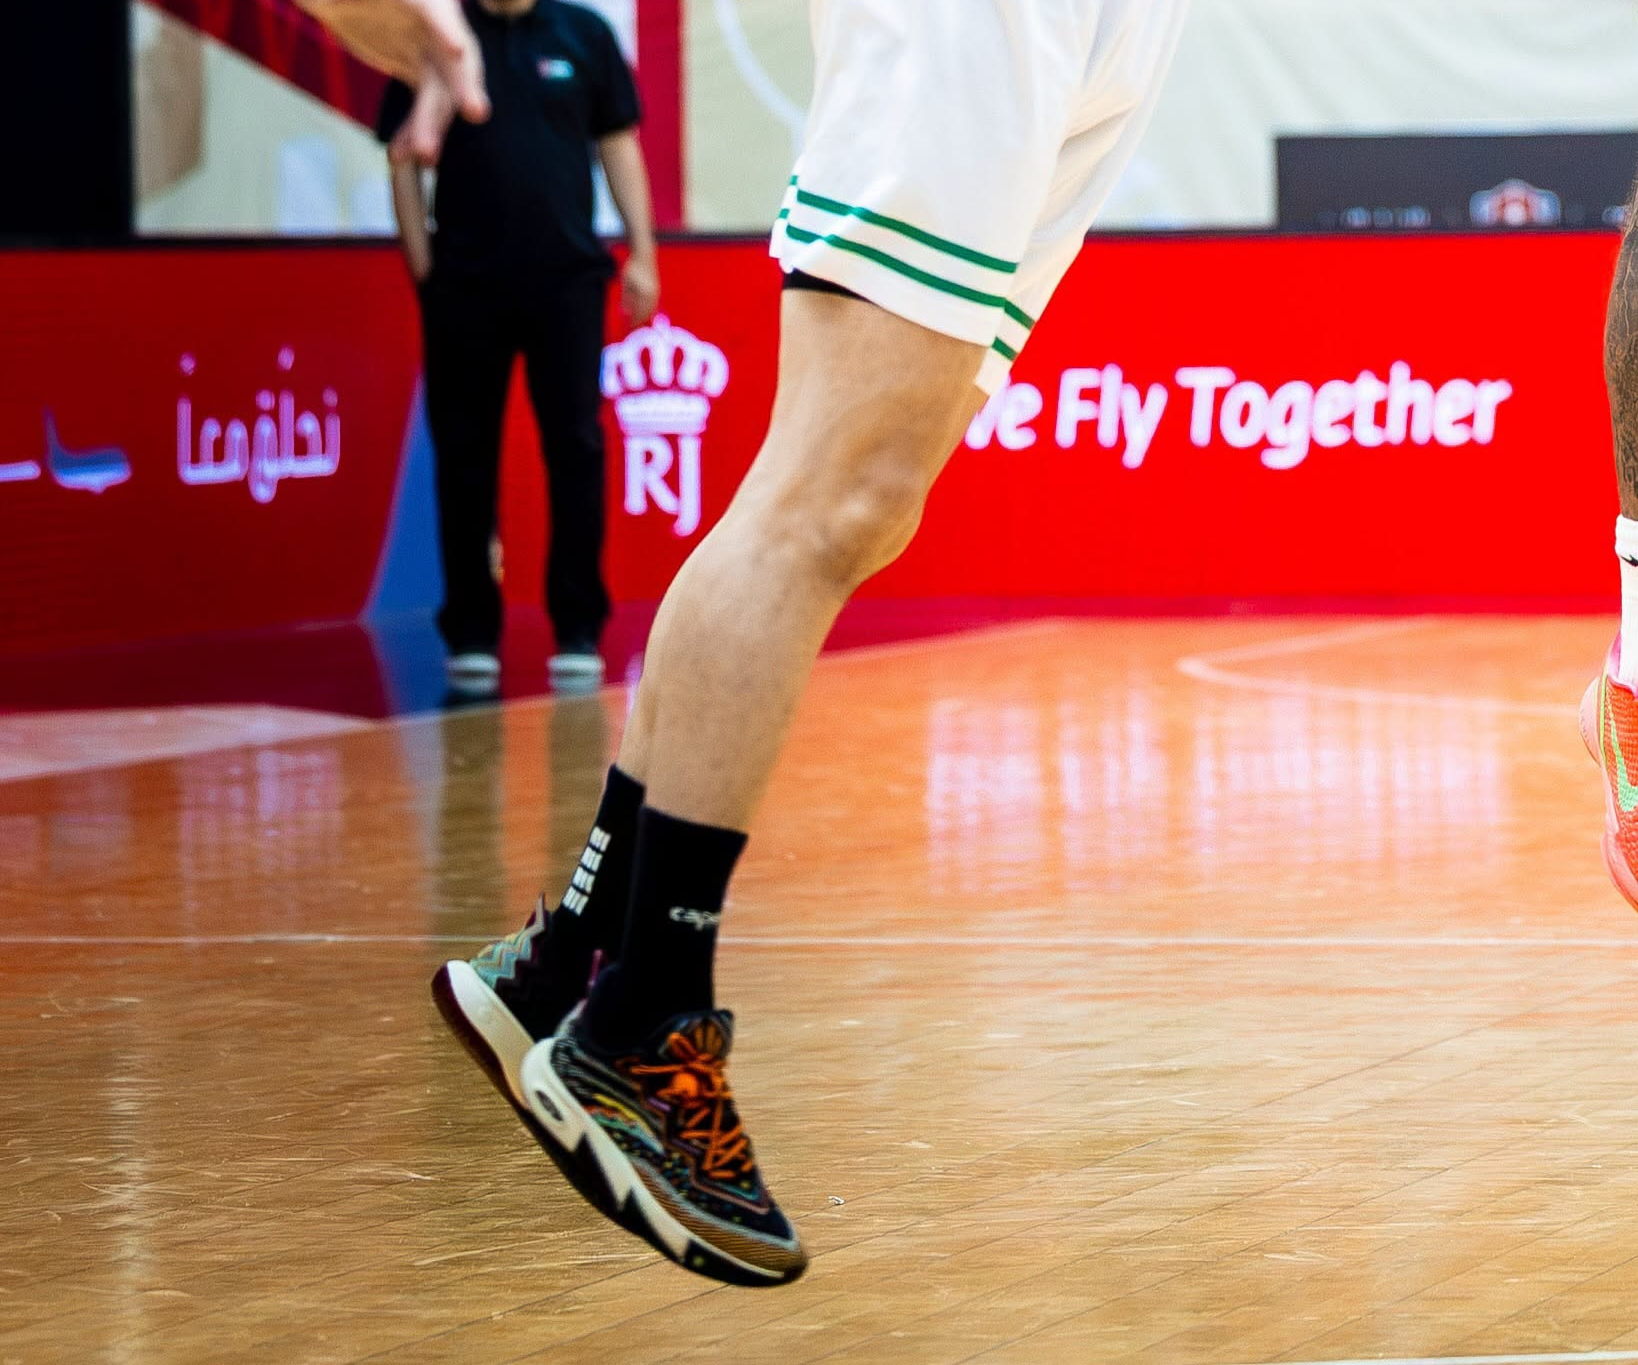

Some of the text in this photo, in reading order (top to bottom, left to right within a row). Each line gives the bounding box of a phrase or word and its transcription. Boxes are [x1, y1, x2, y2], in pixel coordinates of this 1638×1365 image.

[1055, 362, 1169, 470] Fly
[1175, 360, 1512, 470] Together
[623, 434, 701, 537] RJ
